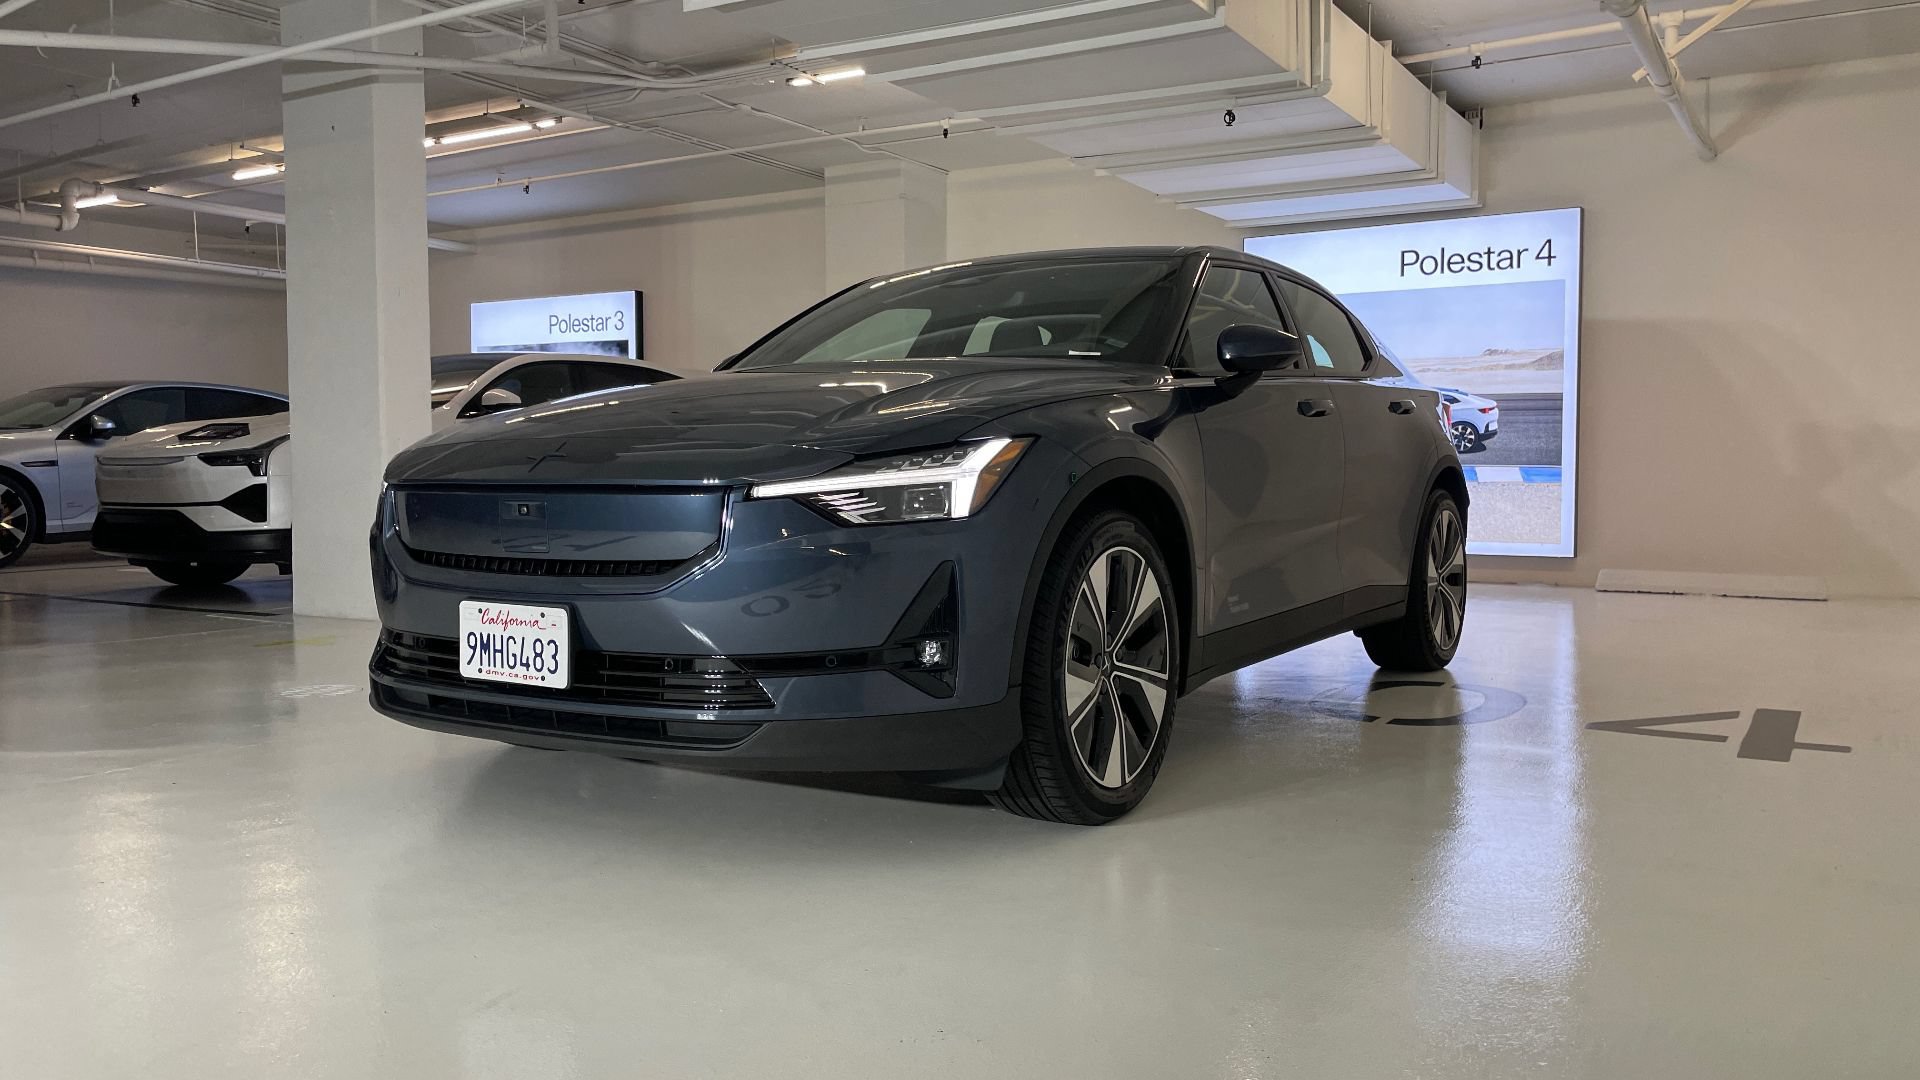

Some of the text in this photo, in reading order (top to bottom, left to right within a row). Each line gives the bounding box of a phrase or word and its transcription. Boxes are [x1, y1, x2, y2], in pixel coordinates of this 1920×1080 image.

[1400, 238, 1557, 277] Polestar 4
[548, 310, 625, 334] Polestar 3
[481, 608, 547, 631] California
[467, 631, 559, 674] 9MHG483
[485, 669, 540, 681] dmv.ca.gov
